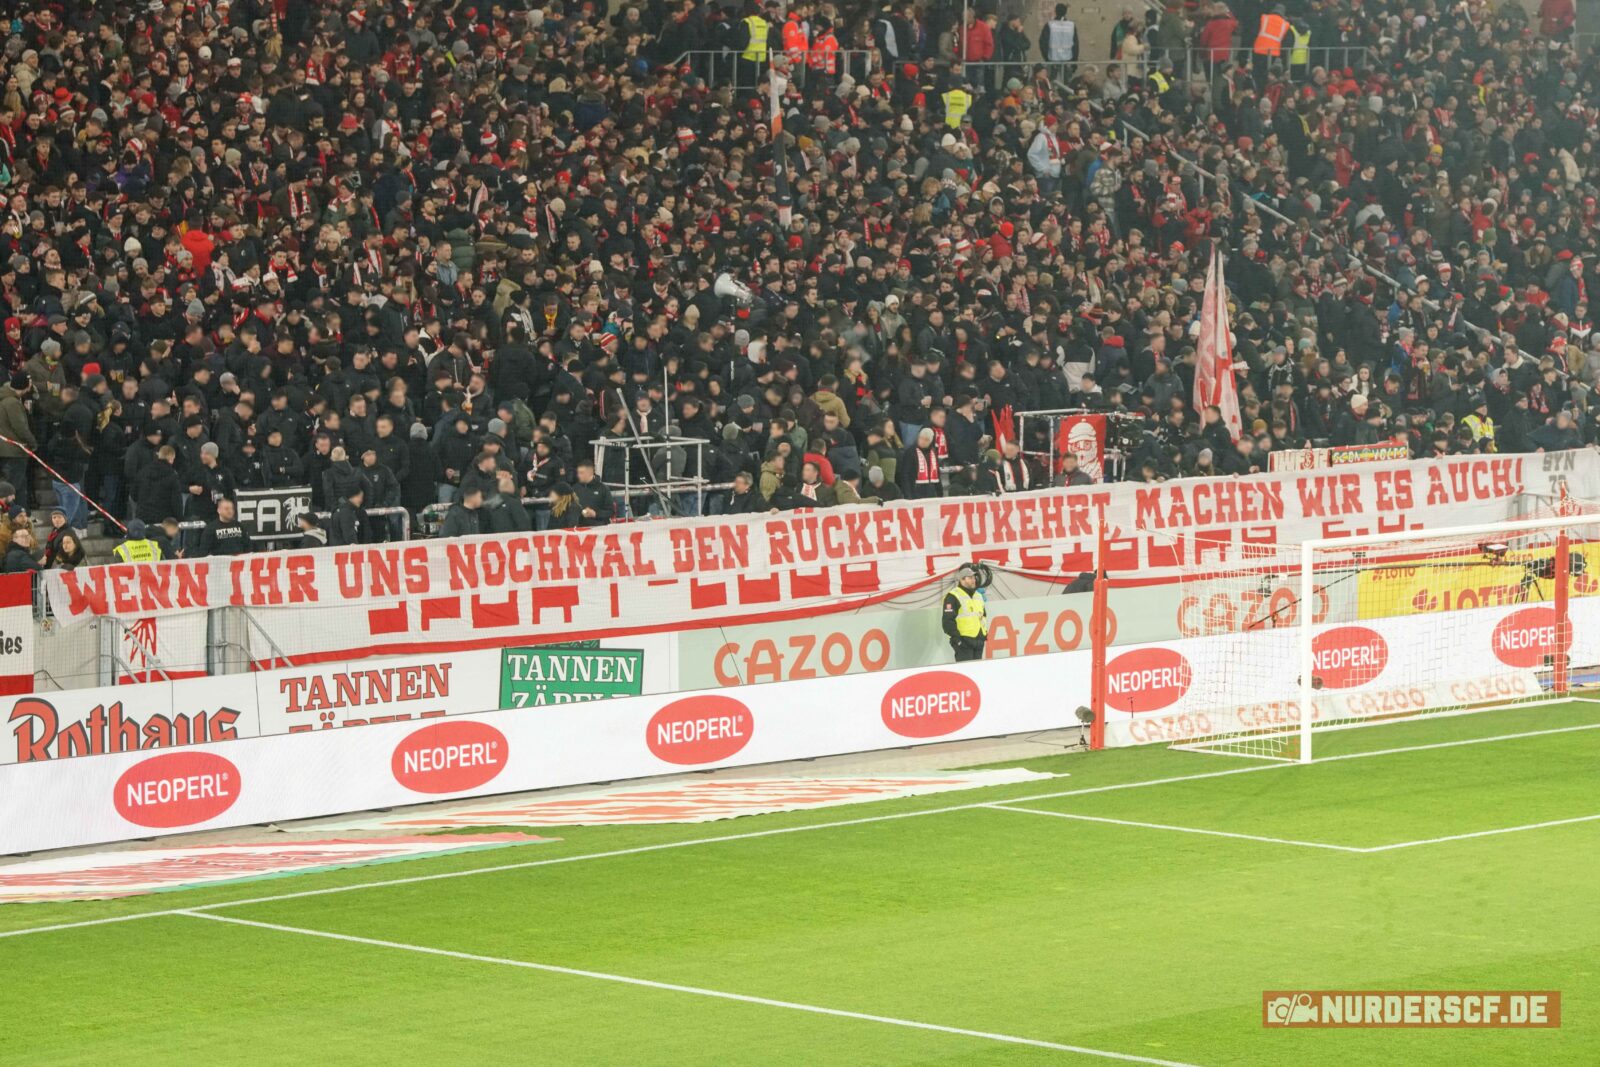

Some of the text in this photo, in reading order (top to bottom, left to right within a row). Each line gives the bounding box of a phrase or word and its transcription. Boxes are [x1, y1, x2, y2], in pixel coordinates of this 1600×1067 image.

[1542, 451, 1576, 471] SYN
[59, 562, 210, 616] WENN
[229, 554, 319, 606] IHR
[334, 546, 430, 598] UNS
[446, 531, 656, 592] NOCHMAL
[669, 524, 750, 574] DEN
[765, 506, 925, 565] RÜCKEN
[1135, 480, 1284, 530] MACHEN
[1296, 473, 1364, 518] WIR
[1373, 469, 1414, 511] ES
[1427, 457, 1524, 506] AUCH!
[985, 606, 1117, 659] AZOO
[1177, 586, 1329, 638] CAZOO
[714, 628, 891, 687] CAZOO
[1500, 625, 1556, 651] NEOPER
[280, 662, 452, 713] TANNEN
[507, 654, 637, 683] TANNEN
[8, 697, 241, 763] Rothaus
[1128, 712, 1212, 742] CAZOO
